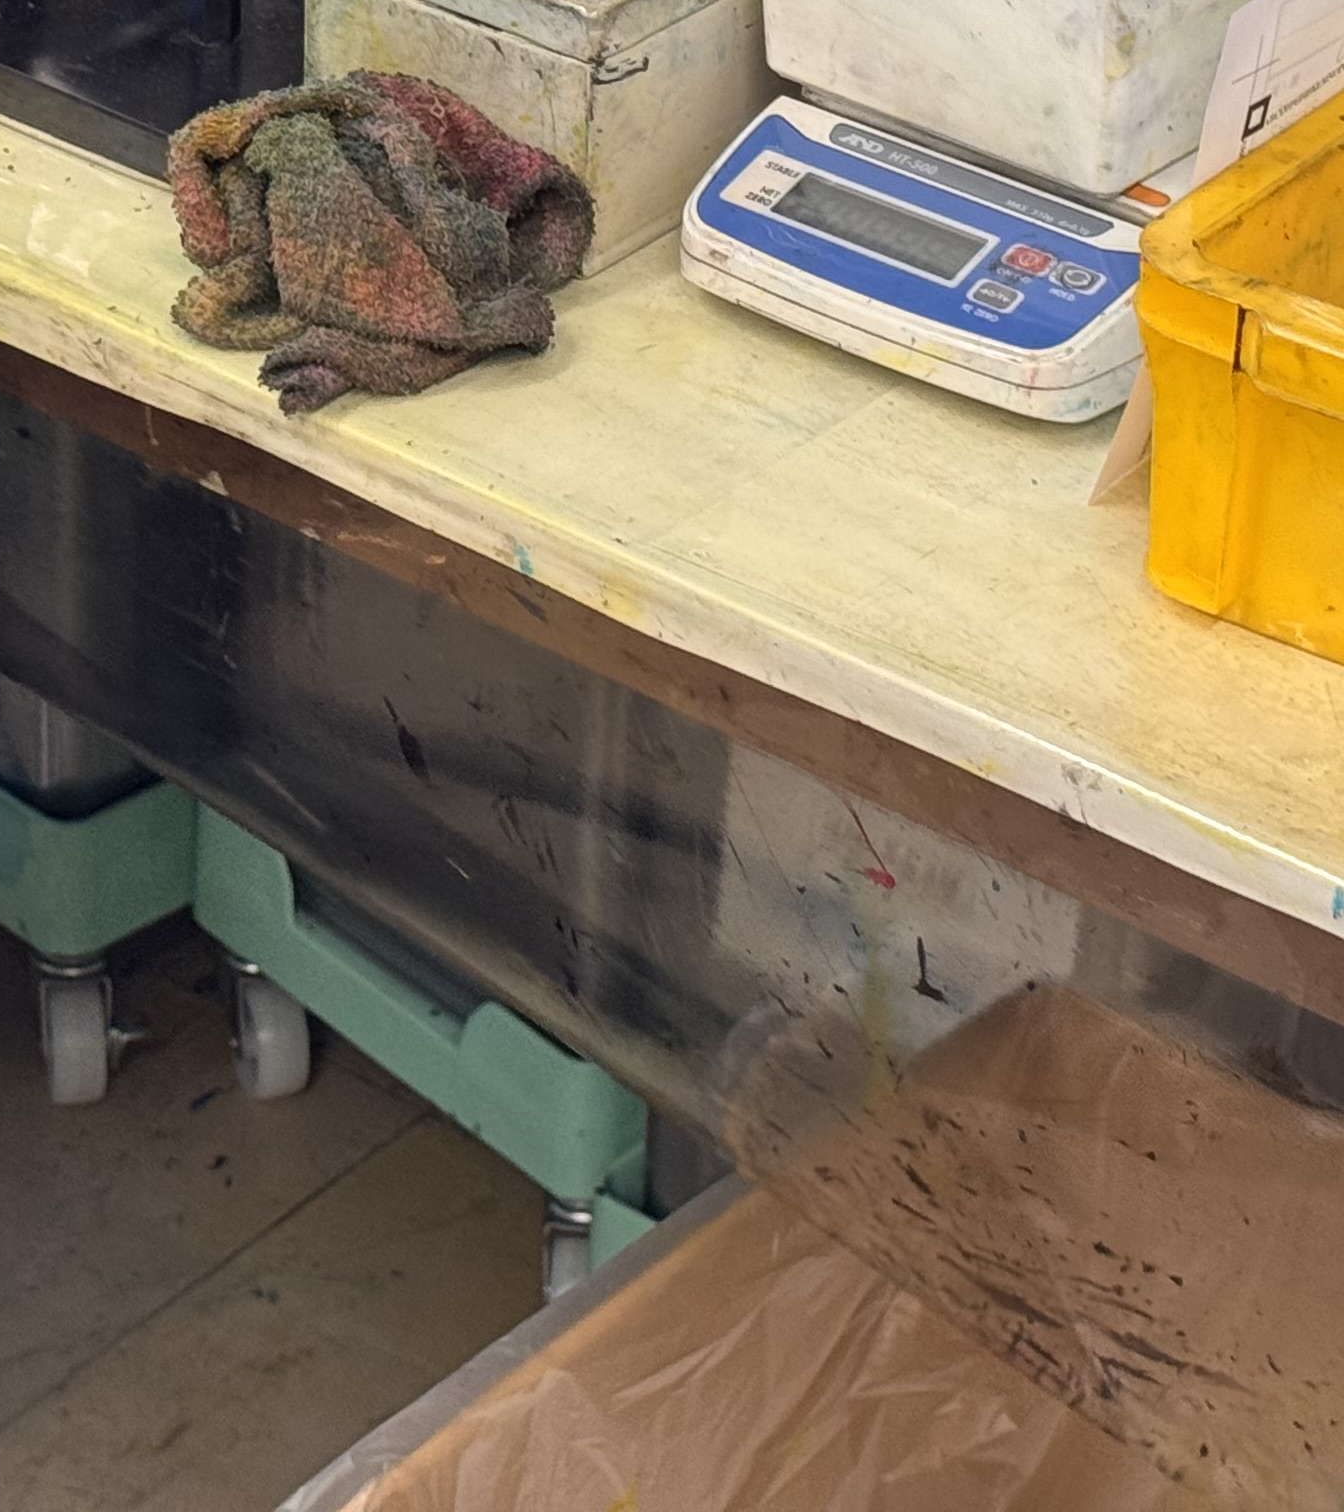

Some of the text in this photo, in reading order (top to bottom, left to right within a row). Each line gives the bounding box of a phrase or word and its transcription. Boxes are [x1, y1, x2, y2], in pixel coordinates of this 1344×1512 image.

[764, 161, 801, 179] STABLE
[888, 151, 938, 176] HT-500
[745, 191, 773, 207] ZERO
[759, 186, 781, 199] NET
[1049, 287, 1076, 302] HOLD
